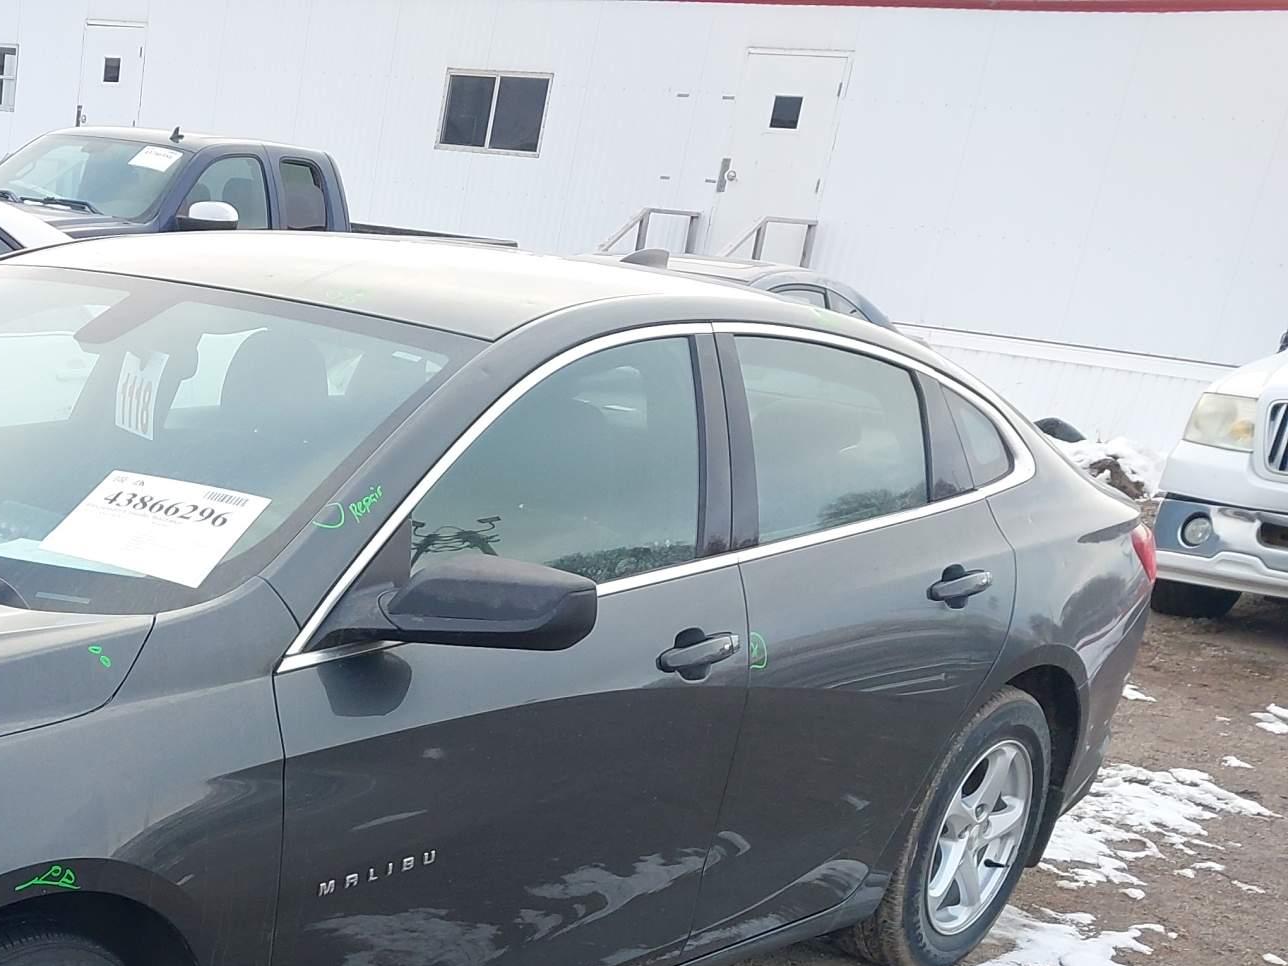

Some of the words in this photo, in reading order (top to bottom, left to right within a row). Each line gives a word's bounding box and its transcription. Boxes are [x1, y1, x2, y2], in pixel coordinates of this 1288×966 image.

[120, 372, 153, 434] 1118
[103, 490, 233, 528] 43866296
[317, 849, 437, 897] MALIBU
